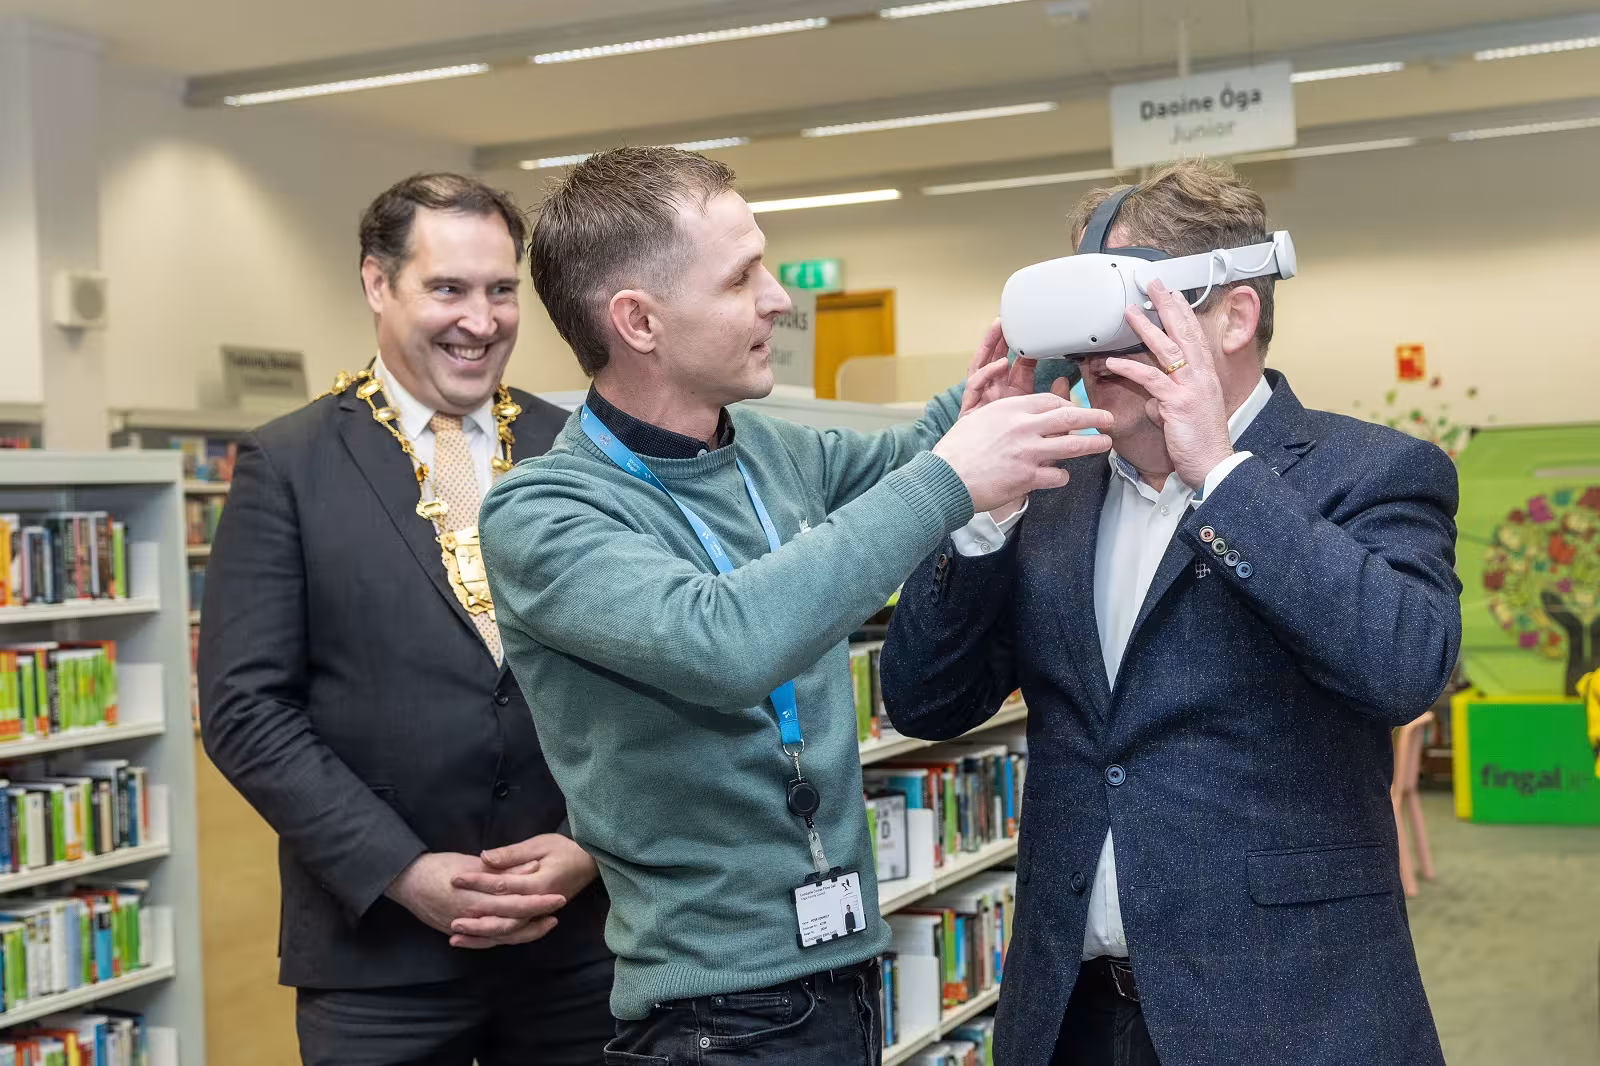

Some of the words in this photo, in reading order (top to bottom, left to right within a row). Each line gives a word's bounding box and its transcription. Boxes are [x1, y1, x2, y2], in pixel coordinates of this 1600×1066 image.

[1140, 94, 1214, 120] Daoine
[1219, 81, 1263, 111] Óga
[1169, 118, 1237, 145] Junior
[774, 305, 808, 331] ooks
[1481, 762, 1562, 799] fingal
